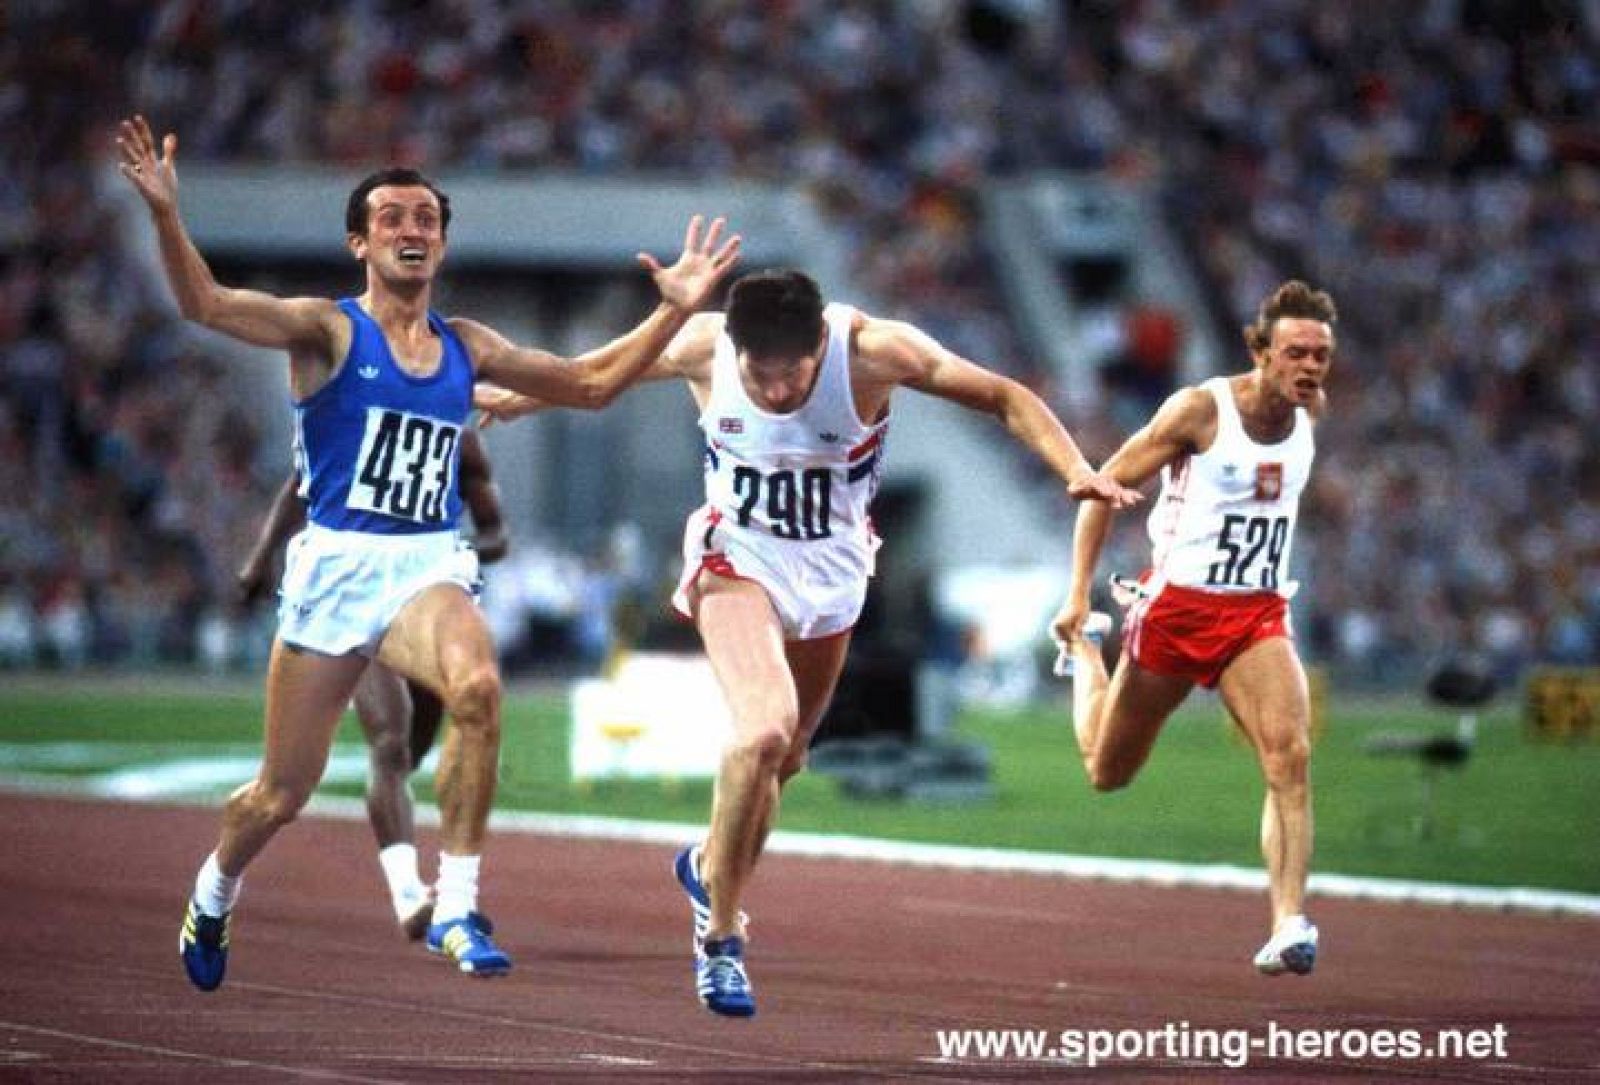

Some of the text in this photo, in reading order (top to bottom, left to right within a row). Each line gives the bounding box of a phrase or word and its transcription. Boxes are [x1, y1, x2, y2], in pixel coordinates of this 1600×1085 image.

[359, 411, 457, 522] 433
[733, 466, 832, 540] 790
[1205, 514, 1289, 589] 529
